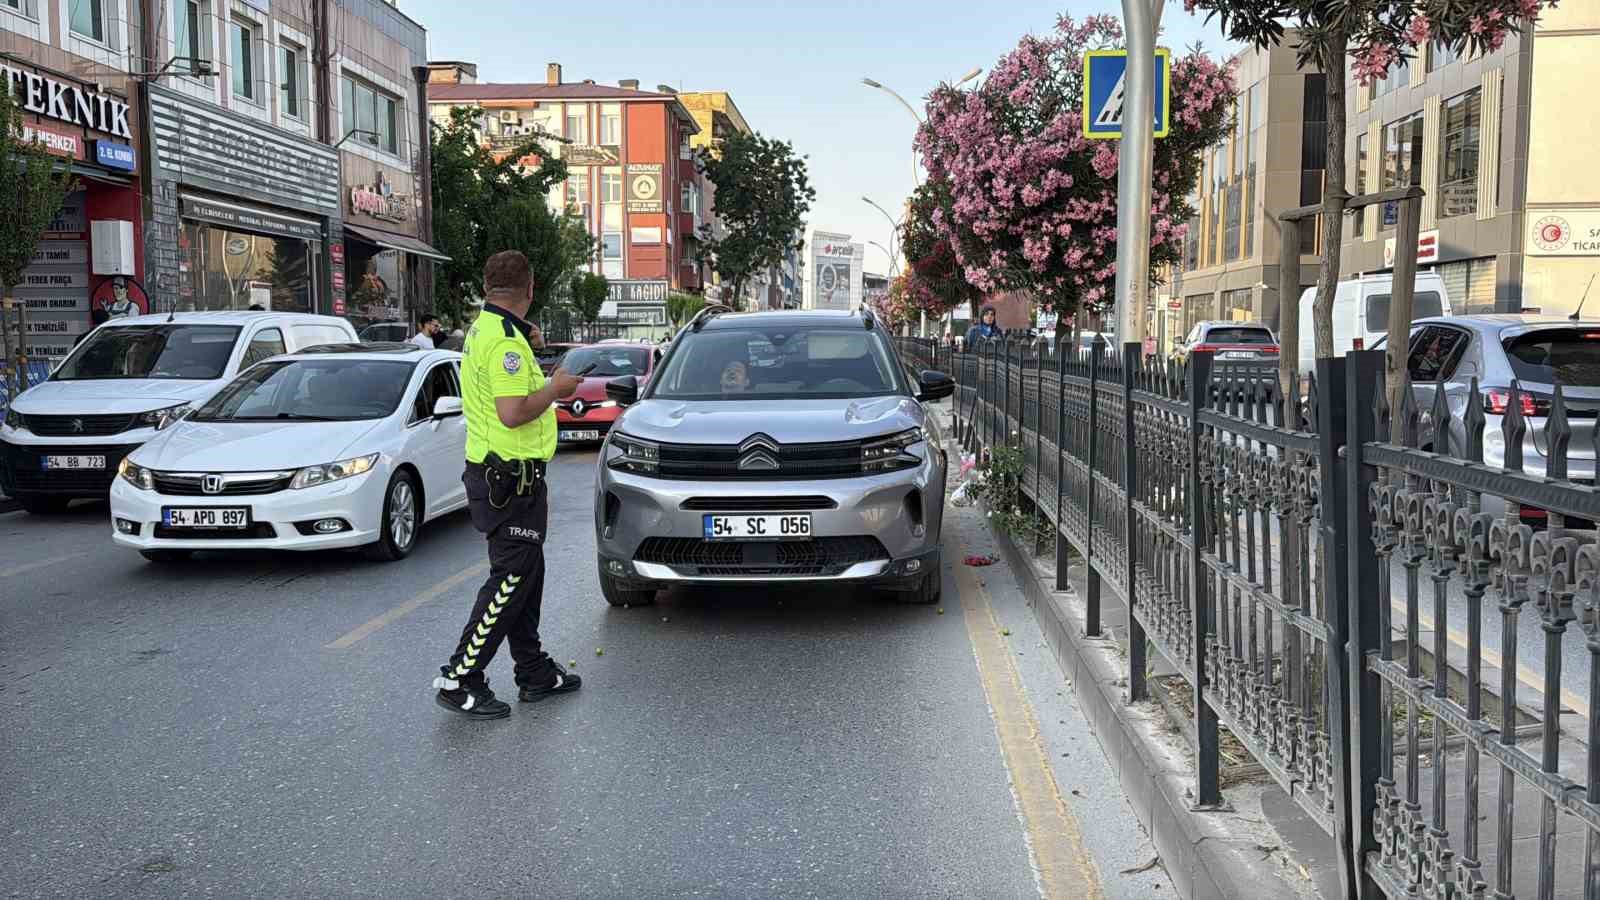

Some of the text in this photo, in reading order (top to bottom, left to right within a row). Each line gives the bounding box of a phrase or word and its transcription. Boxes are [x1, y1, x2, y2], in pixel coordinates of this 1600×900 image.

[0, 63, 133, 139] TEKNİK
[87, 456, 105, 468] 723
[171, 510, 245, 525] 54 APD 897
[713, 516, 809, 535] 54 SC 056
